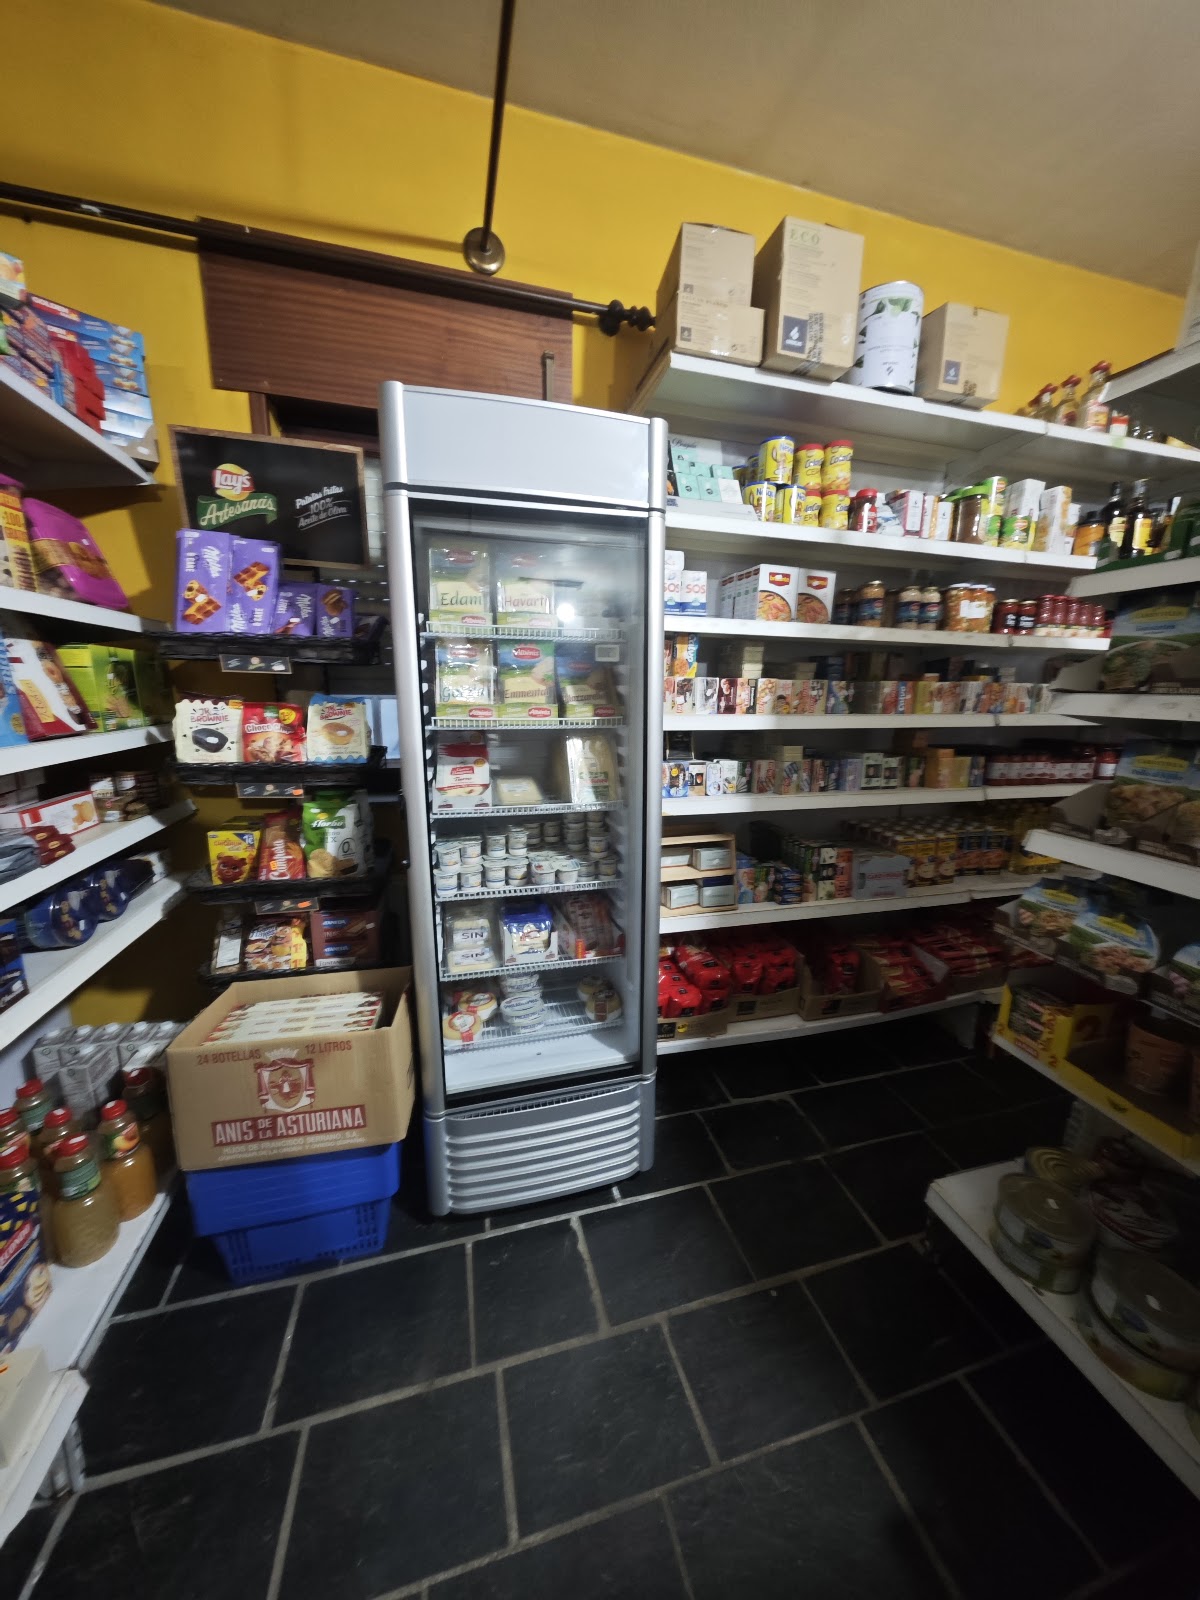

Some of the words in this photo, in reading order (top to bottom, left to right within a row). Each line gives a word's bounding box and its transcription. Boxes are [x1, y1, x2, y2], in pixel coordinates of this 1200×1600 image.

[215, 470, 252, 494] Lay's
[310, 497, 335, 514] 100%
[201, 546, 223, 578] Milka
[685, 585, 706, 594] SOS
[296, 593, 316, 619] Milka
[440, 592, 483, 606] Edam
[190, 714, 229, 723] BROWNIE
[462, 932, 485, 940] SIN
[304, 1044, 317, 1055] 12
[318, 1040, 352, 1054] LITROS
[196, 1053, 212, 1065] 24
[213, 1049, 261, 1064] BOTELLAS
[257, 1118, 273, 1130] DE
[275, 1107, 365, 1137] ASTURIANA
[215, 1120, 253, 1146] ANIS
[258, 1130, 273, 1140] LA
[261, 1137, 304, 1151] FRANCISCO
